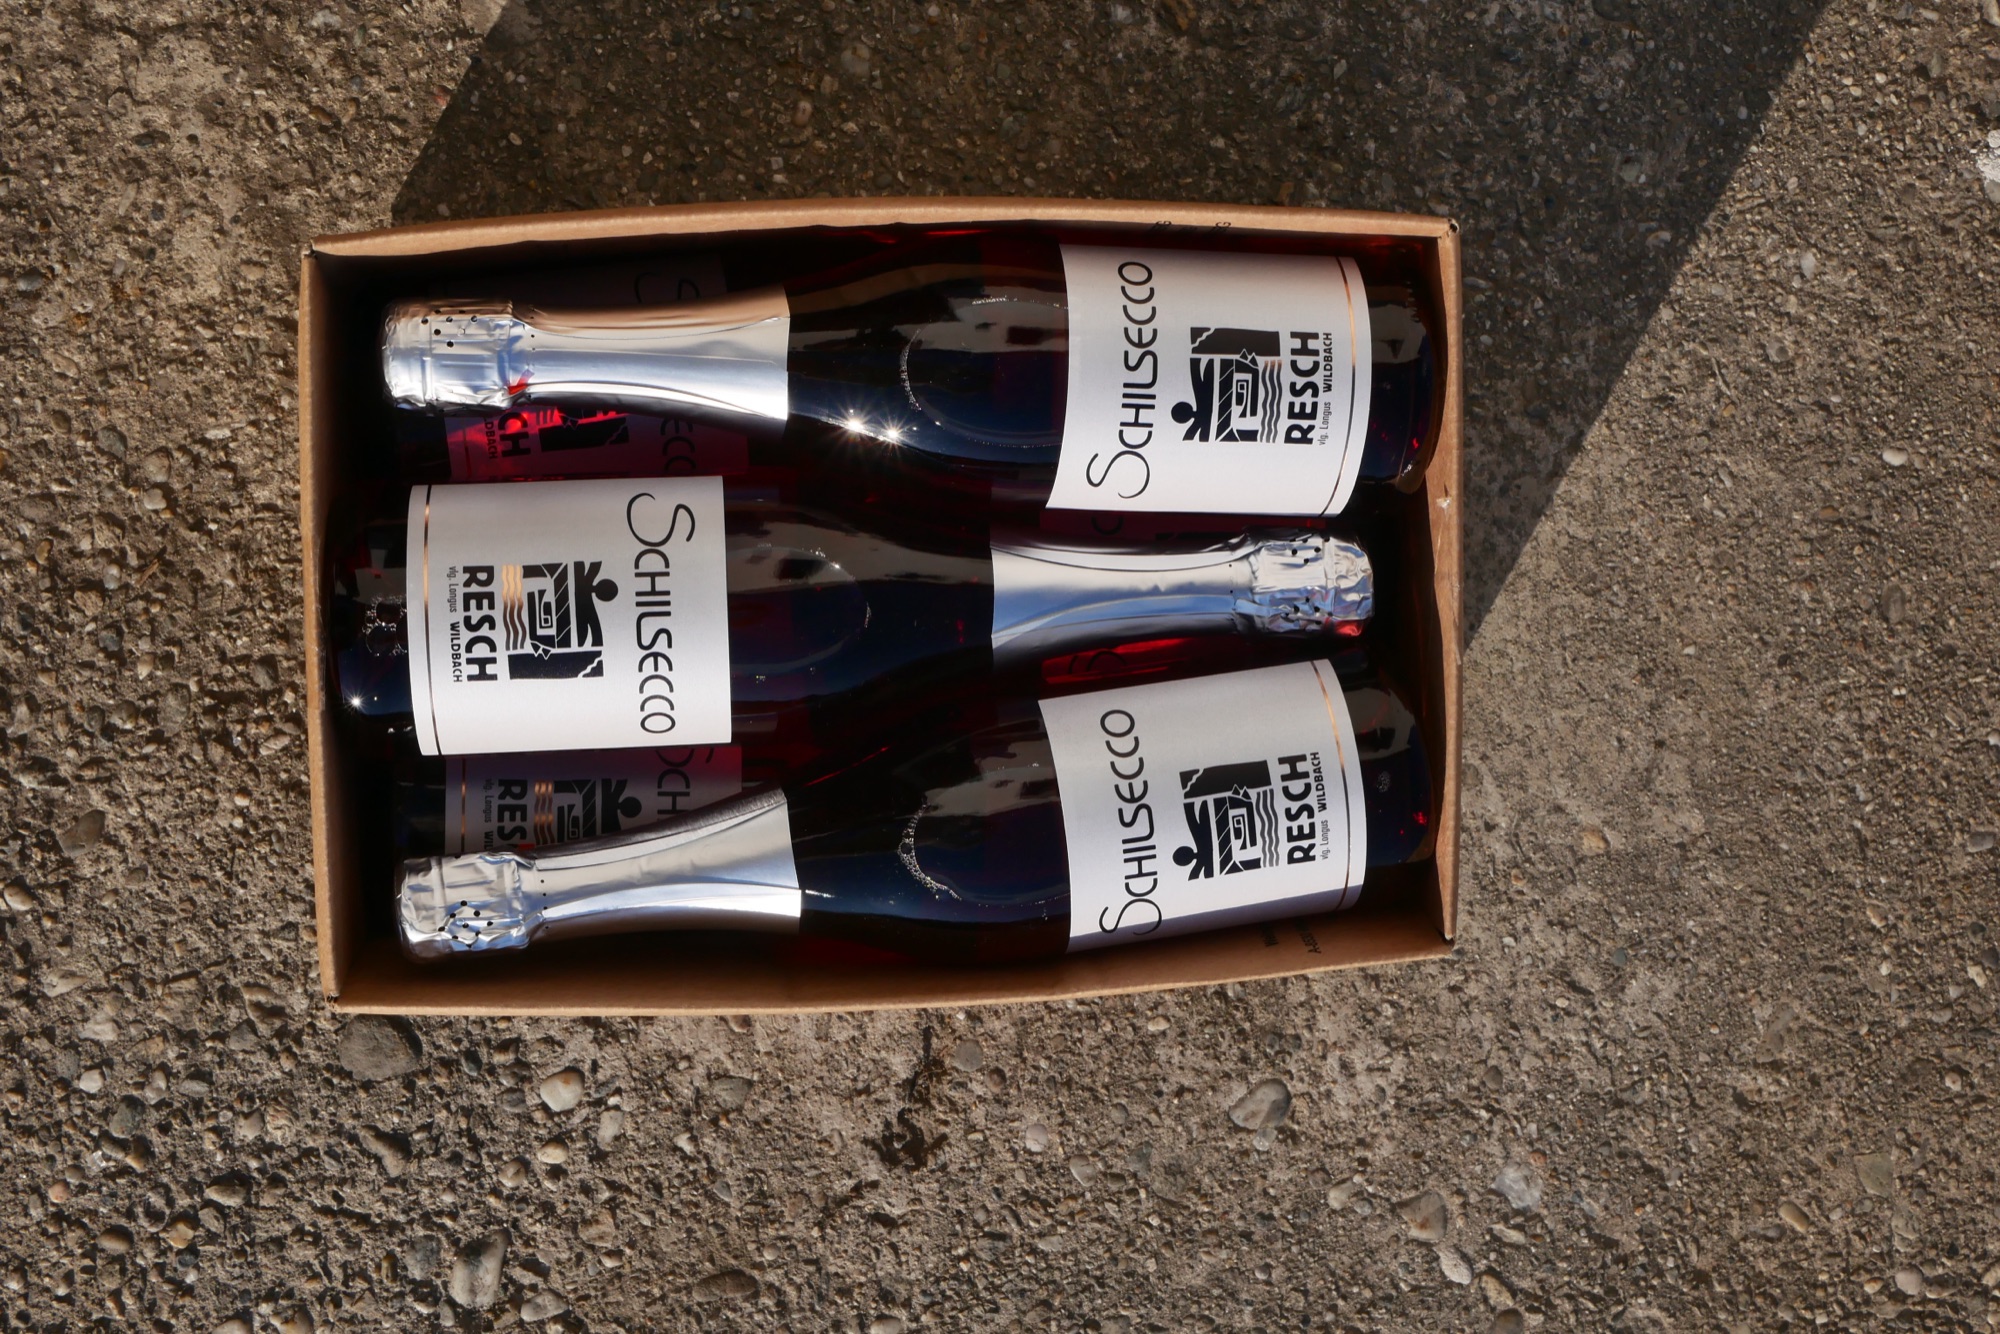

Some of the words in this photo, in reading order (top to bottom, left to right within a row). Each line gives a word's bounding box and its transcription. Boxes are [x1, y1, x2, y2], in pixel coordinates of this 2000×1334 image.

[1086, 261, 1158, 499] SCHILSECCO
[1284, 331, 1320, 446] RESCH
[1322, 332, 1333, 393] WILDBACH
[1317, 432, 1328, 446] vlg.
[1319, 401, 1332, 430] Longus
[448, 565, 457, 581] vlg.
[448, 583, 457, 613] Longus
[462, 565, 498, 682] RESCH
[626, 492, 696, 734] SCHILSECCO
[450, 622, 463, 683] WILDBACH
[483, 795, 494, 823] Longus
[1277, 753, 1316, 865] RESCH
[1310, 751, 1328, 812] WILDBACH
[1099, 709, 1162, 936] SCHILSECCO
[1319, 819, 1330, 846] Longus
[1320, 846, 1330, 860] vlg.
